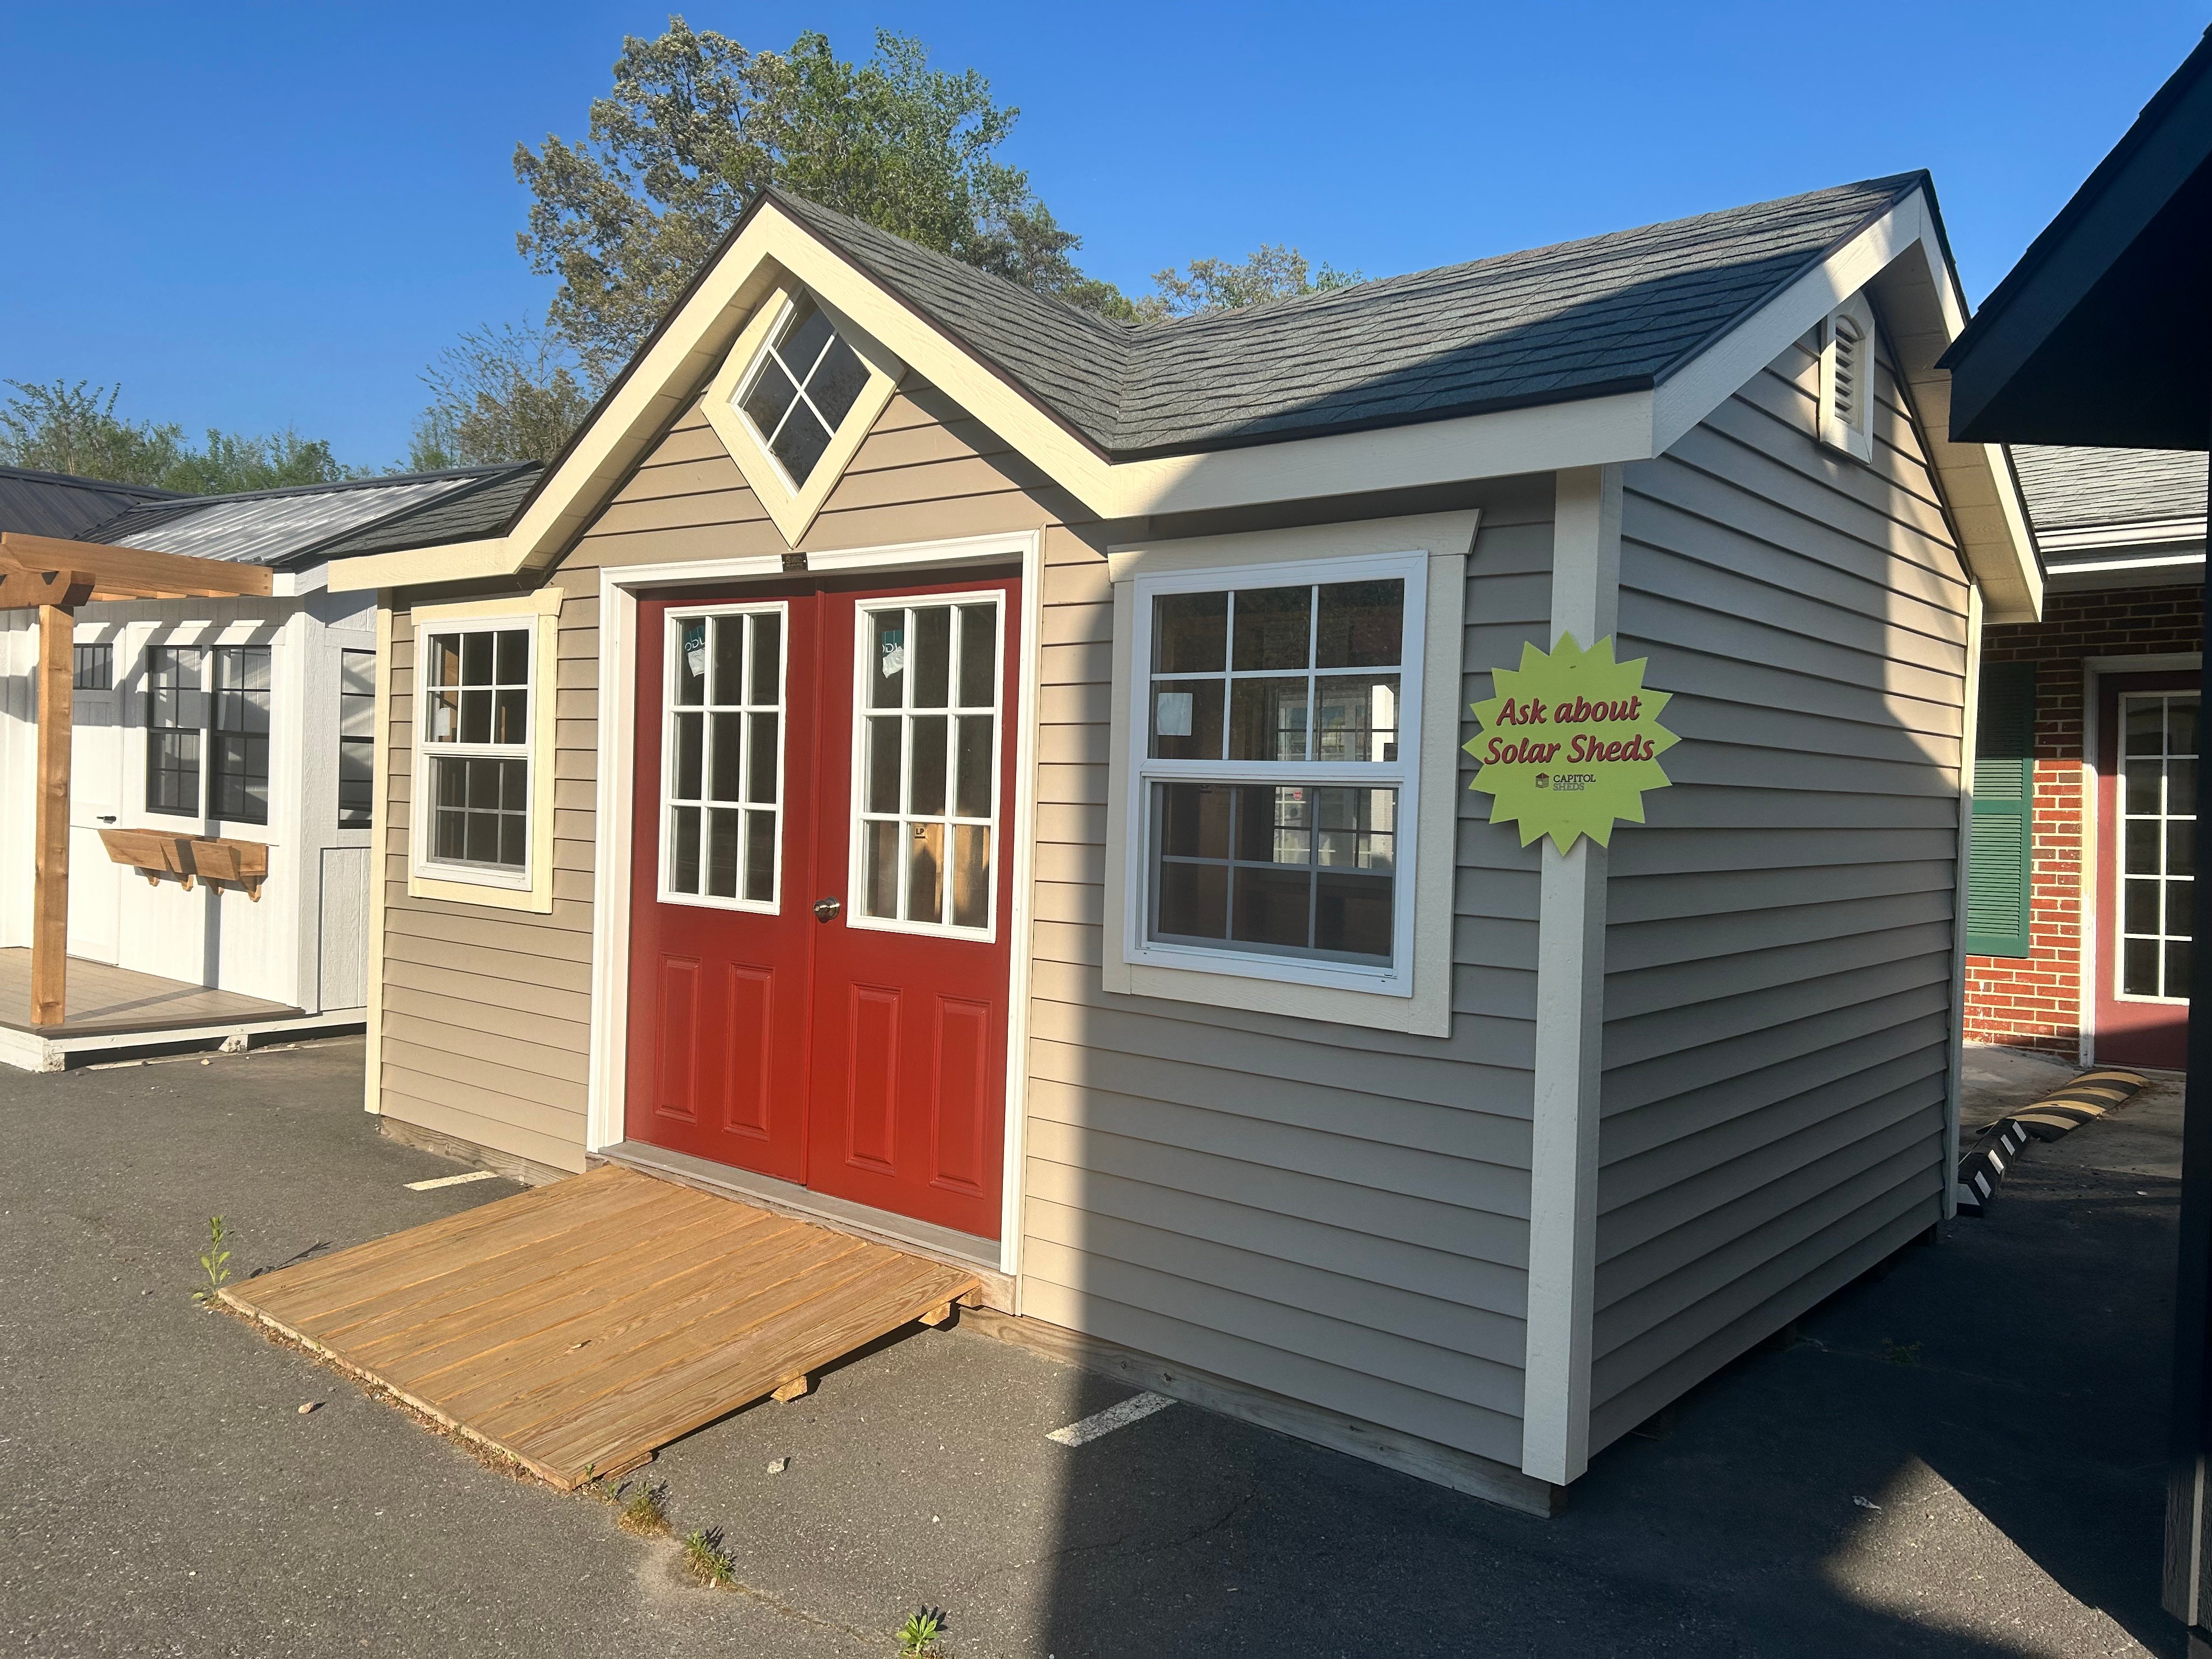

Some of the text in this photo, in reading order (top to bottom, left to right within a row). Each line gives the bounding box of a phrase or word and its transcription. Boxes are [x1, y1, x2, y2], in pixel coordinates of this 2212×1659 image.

[685, 637, 706, 651] ODL
[1496, 695, 1642, 726] Ask about
[1484, 733, 1655, 765] Solar Sheds
[1553, 774, 1596, 783] CAPITOL
[1553, 782, 1584, 791] SHEDS
